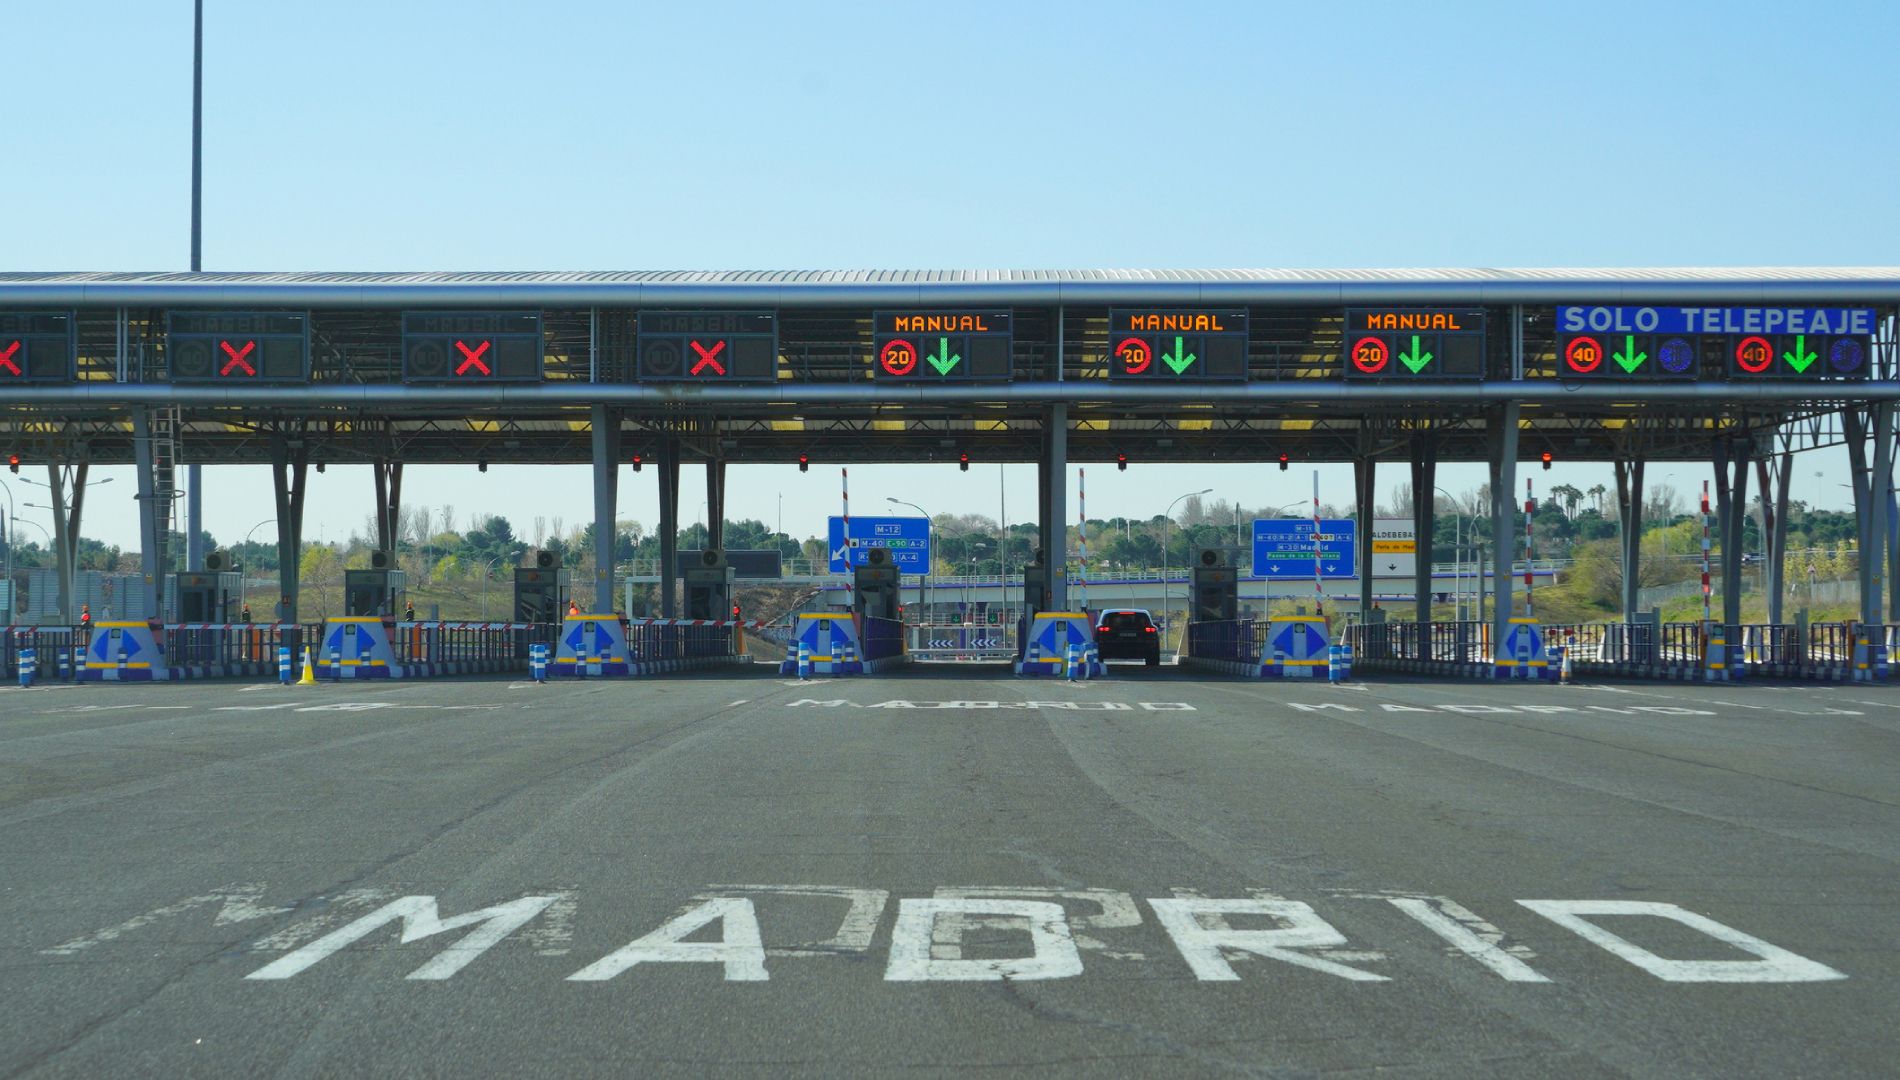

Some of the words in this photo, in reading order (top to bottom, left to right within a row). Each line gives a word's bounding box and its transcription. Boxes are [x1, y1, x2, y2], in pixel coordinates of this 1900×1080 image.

[895, 315, 988, 332] MANUAL
[1130, 314, 1224, 331] MANUAL
[1367, 313, 1461, 330] MANUAL
[1564, 307, 1659, 332] SOLO
[1680, 308, 1869, 334] TELEPEAJE
[887, 350, 909, 365] 20
[1122, 349, 1144, 363] 20
[1358, 347, 1381, 362] 20
[1572, 346, 1595, 362] 40
[1742, 346, 1765, 362] 40
[784, 698, 1197, 711] MADRID
[1286, 702, 1717, 715] MADRID
[244, 895, 1849, 983] MADRID
